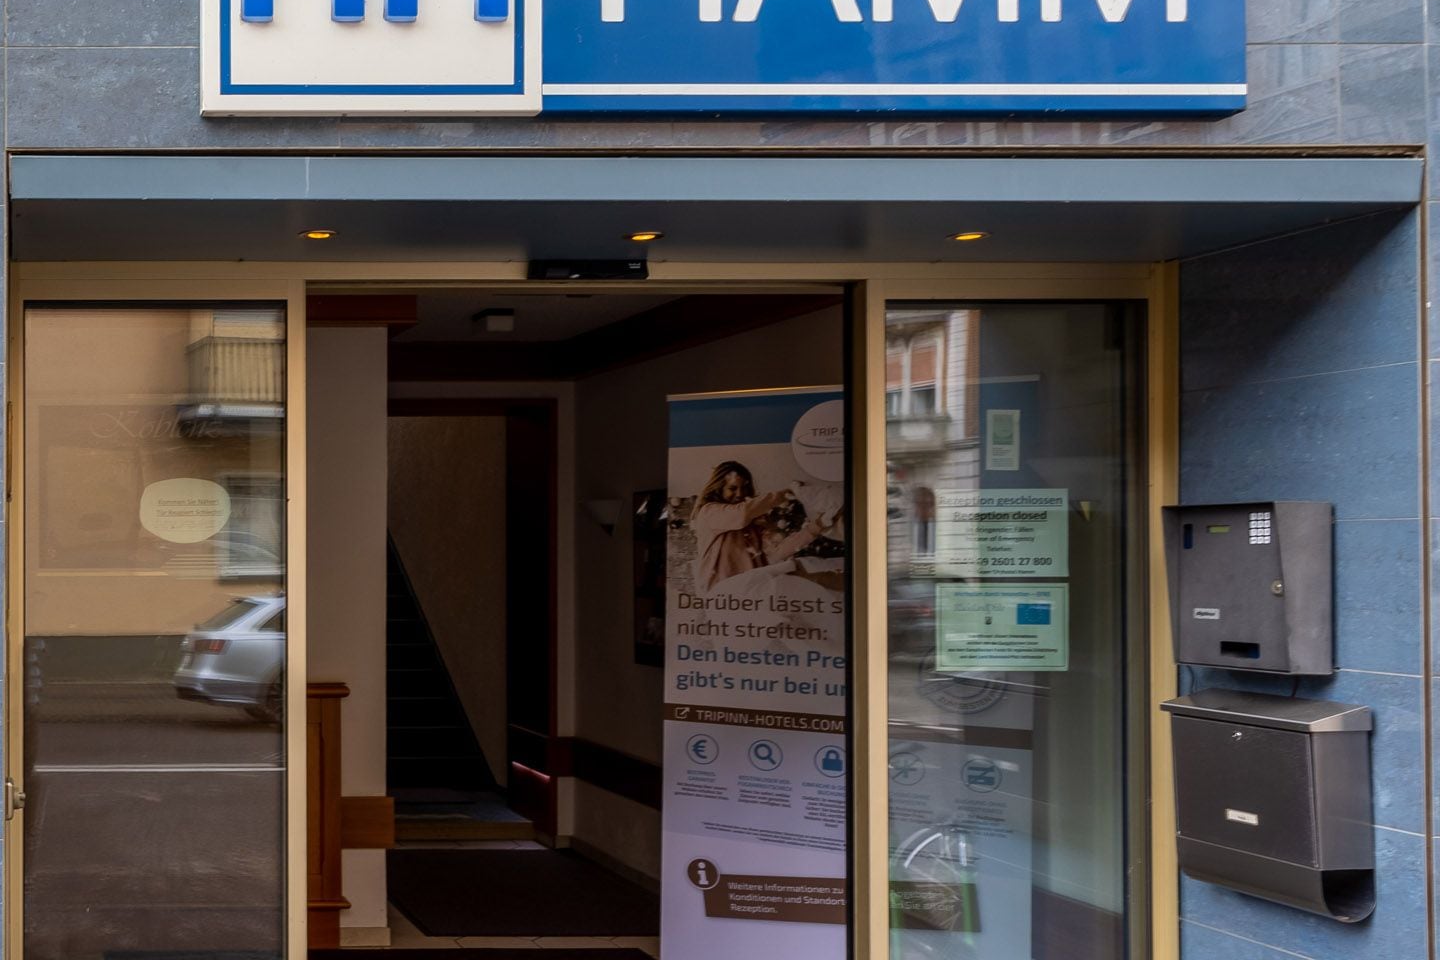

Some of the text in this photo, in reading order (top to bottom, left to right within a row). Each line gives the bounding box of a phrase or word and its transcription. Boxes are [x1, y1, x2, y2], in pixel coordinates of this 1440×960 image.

[808, 427, 839, 437] TRIP
[997, 495, 1063, 507] geschlossen
[953, 510, 1048, 522] Reception closed
[991, 557, 1016, 567] 2601
[1019, 557, 1032, 567] 27
[1033, 557, 1053, 567] 800
[677, 592, 764, 612] Darüber
[769, 595, 825, 614] lässt
[676, 619, 828, 641] nicht streiten:
[676, 644, 718, 663] Den
[723, 646, 800, 667] besten
[740, 677, 778, 693] nur
[784, 676, 818, 695] bei
[695, 709, 844, 732] TRIPINN-HOTELS.COM
[727, 881, 763, 891] Weitere
[764, 883, 831, 894] Informationen
[784, 895, 803, 904] und
